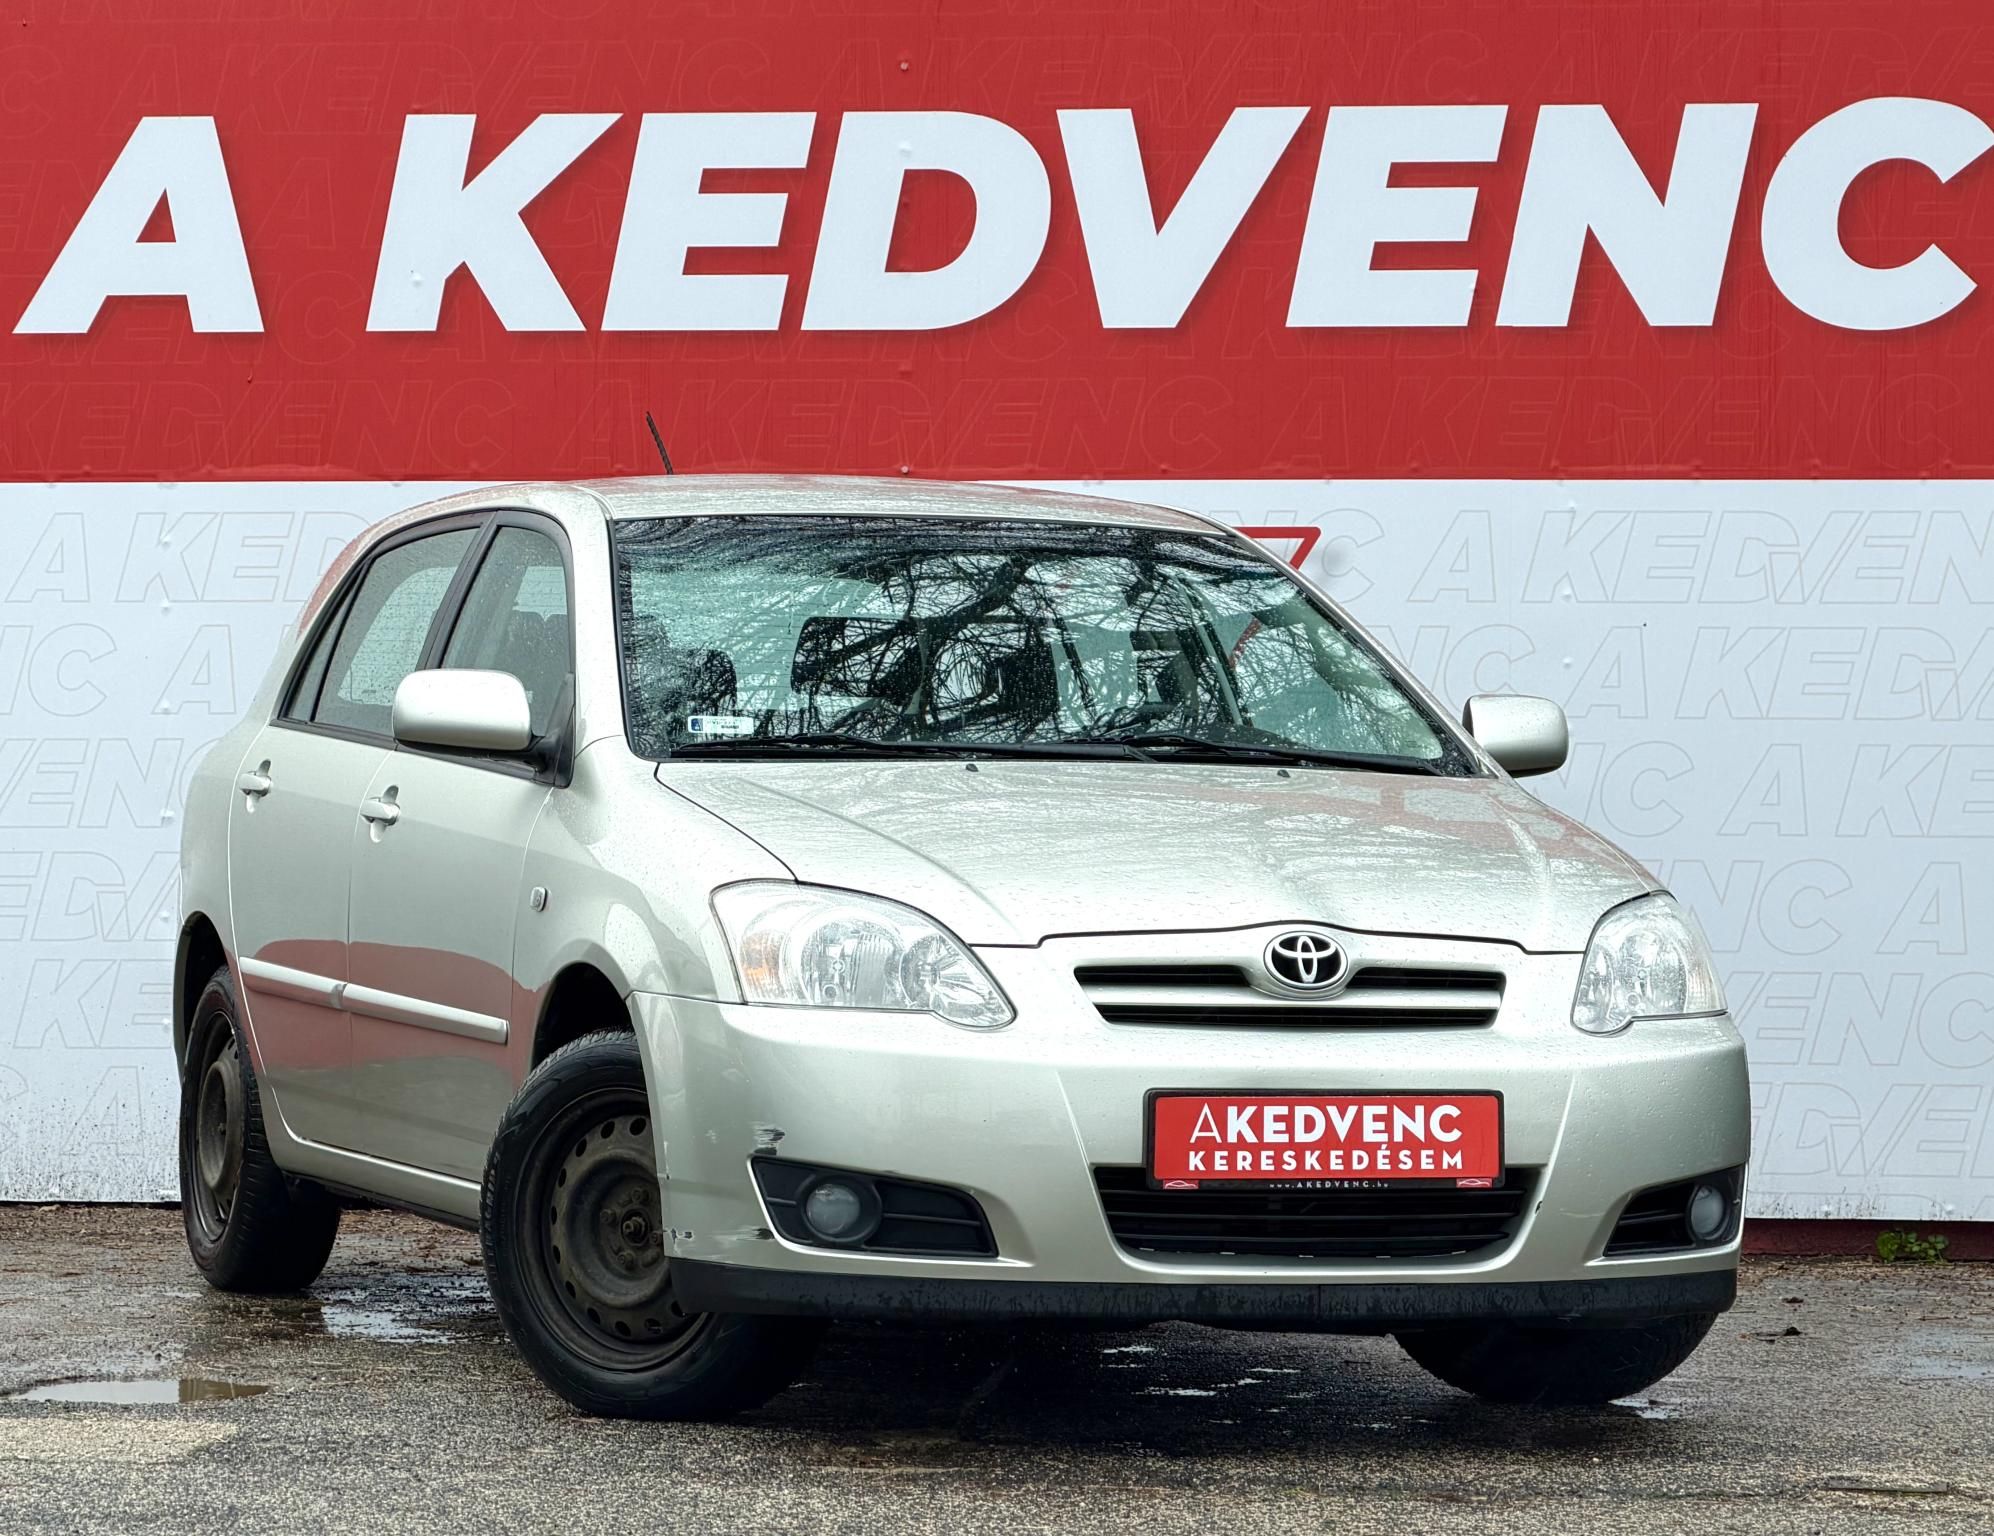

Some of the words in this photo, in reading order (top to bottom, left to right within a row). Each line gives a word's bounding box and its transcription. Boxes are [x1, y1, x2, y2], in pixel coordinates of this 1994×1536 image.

[12, 115, 265, 334] A
[365, 97, 1994, 333] KEDVENC
[1189, 1102, 1463, 1143] AKEDVENC
[1188, 1144, 1463, 1171] KERESKEDÉSEM
[1269, 1180, 1389, 1189] www.AKEDVENC.hu
